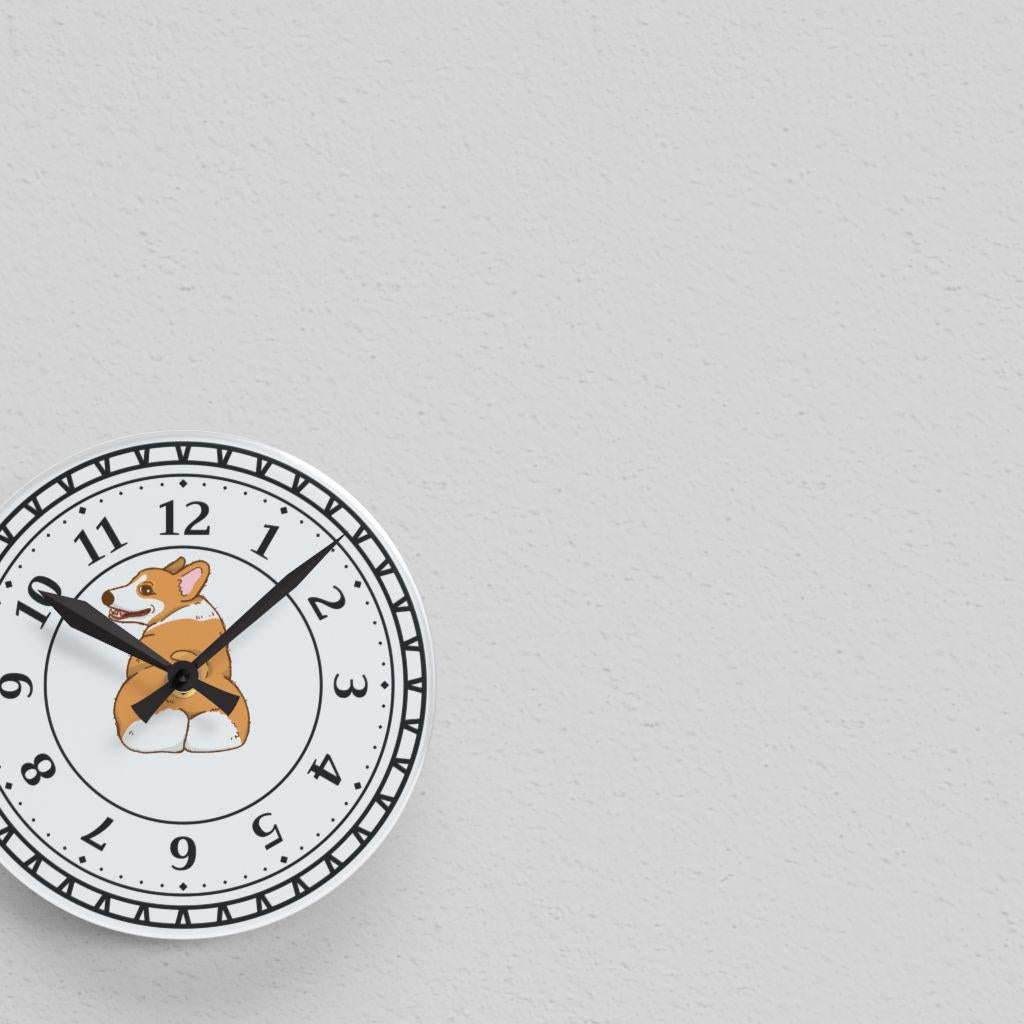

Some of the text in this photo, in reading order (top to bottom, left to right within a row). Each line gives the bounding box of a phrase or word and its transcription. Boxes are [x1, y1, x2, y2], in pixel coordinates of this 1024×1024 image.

[159, 500, 211, 536] 12
[73, 516, 128, 566] 11
[250, 523, 280, 560] 1
[15, 575, 62, 630] 10
[307, 585, 346, 621] 2
[333, 673, 369, 699] 3
[20, 752, 57, 786] 8
[307, 753, 342, 787] 4
[80, 816, 114, 852] 7
[252, 812, 284, 851] 5
